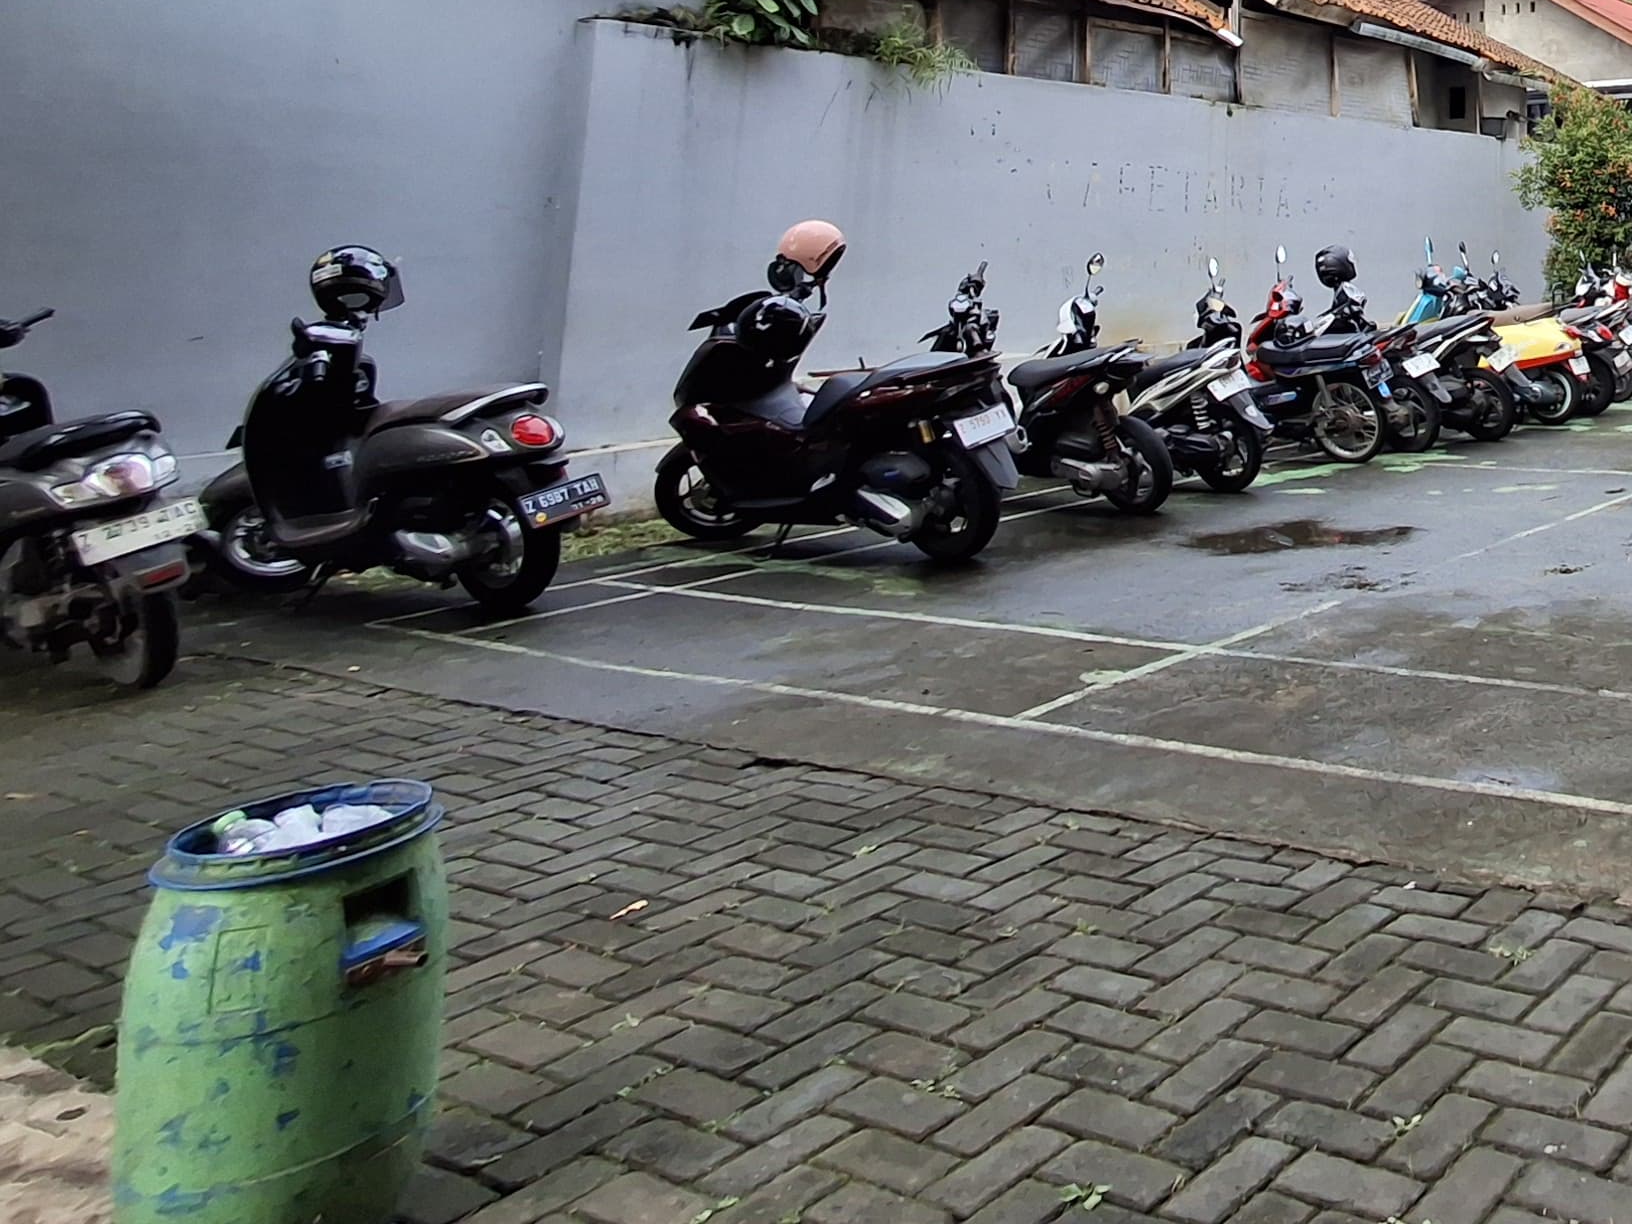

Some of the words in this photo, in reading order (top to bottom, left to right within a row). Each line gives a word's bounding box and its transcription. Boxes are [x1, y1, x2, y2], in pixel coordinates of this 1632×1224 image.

[525, 500, 537, 514] Z
[539, 487, 570, 508] 6987
[574, 478, 600, 496] TAH
